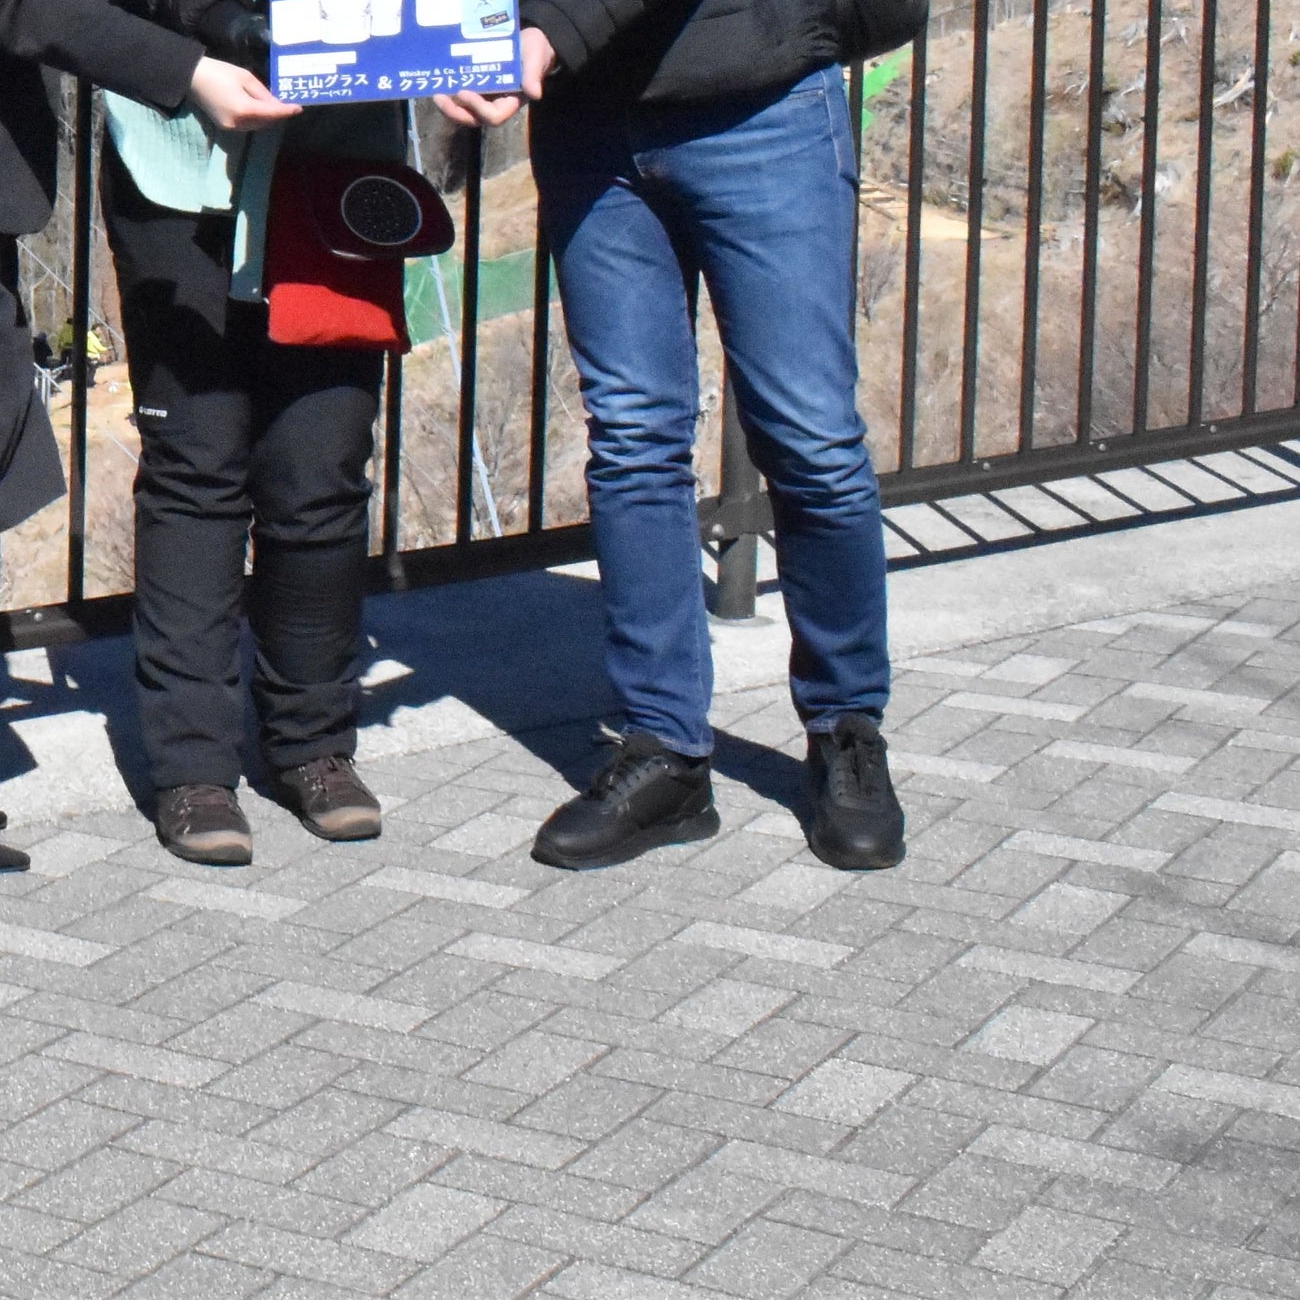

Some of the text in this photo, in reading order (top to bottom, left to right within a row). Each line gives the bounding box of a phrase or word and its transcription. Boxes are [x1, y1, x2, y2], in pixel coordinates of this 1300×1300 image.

[399, 70, 431, 79] Whiskey
[278, 73, 369, 91] 富士山グラス
[377, 76, 393, 90] &
[399, 73, 490, 92] クラフトジン
